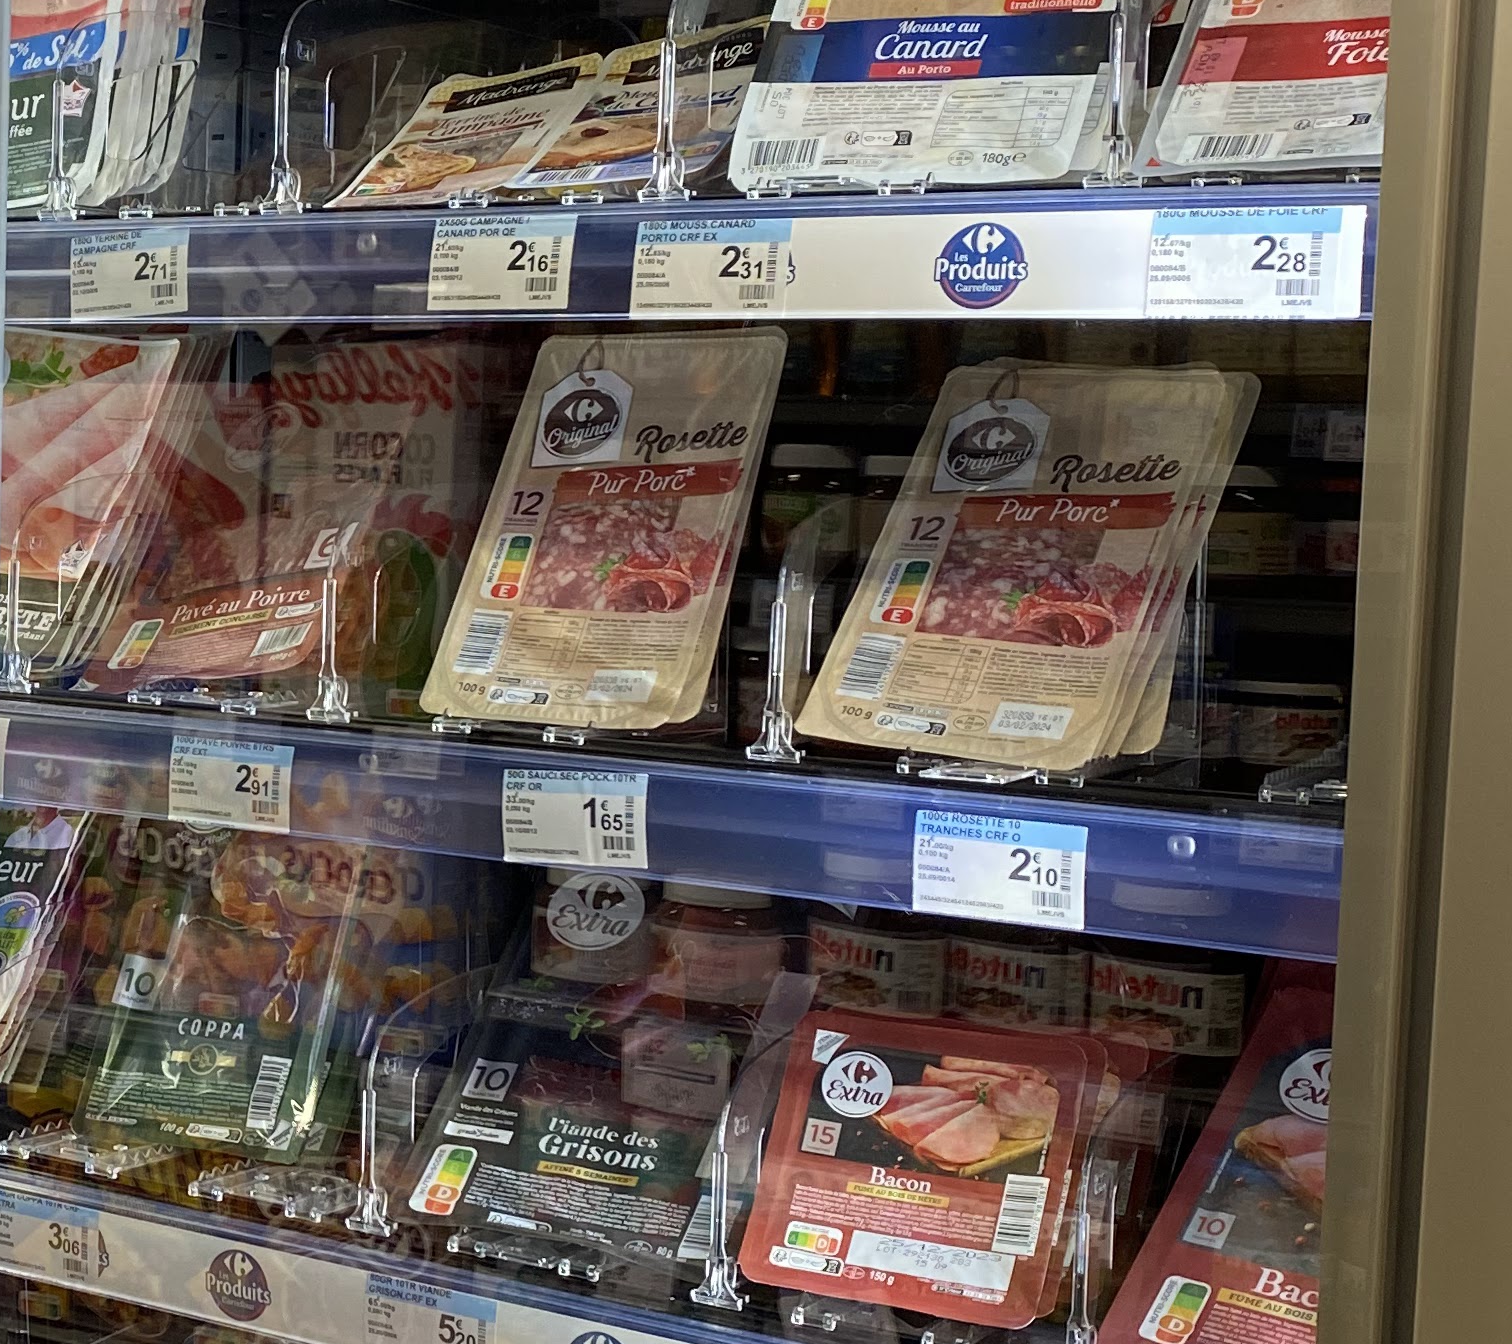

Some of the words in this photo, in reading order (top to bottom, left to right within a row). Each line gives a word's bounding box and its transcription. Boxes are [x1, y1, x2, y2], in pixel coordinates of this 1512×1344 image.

[897, 20, 958, 35] Mousse
[961, 22, 981, 34] au
[1324, 27, 1388, 43] Mousse
[875, 34, 988, 61] Canard
[898, 65, 914, 75] Au
[917, 64, 952, 76] Porto
[457, 76, 566, 105] Madrange
[436, 228, 474, 238] CANARD
[476, 228, 499, 237] POR
[640, 232, 673, 243] PORTO
[676, 232, 699, 242] CRF
[702, 232, 717, 241] EX
[935, 258, 1028, 281] Produits
[955, 282, 1003, 293] Carrefour
[547, 421, 618, 448] Original
[634, 422, 748, 462] Rosette
[950, 445, 1031, 474] Original
[588, 473, 627, 496] Pur
[1050, 454, 1182, 492] Rosette
[513, 491, 545, 515] 12
[996, 498, 1041, 523] Pur
[910, 516, 947, 540] 12
[170, 600, 215, 625] Pavé
[216, 600, 241, 614] au
[247, 586, 311, 608] Poivre
[506, 781, 525, 790] CRF
[528, 782, 543, 791] OR
[920, 823, 983, 838] TRANCHES
[985, 830, 1009, 840] CRF
[552, 905, 630, 937] Extra
[124, 967, 155, 997] 10
[178, 1017, 245, 1041] COPPA
[474, 1064, 514, 1091] 10
[826, 1079, 884, 1106] Extra
[549, 1118, 619, 1143] Viande
[623, 1129, 660, 1149] des
[811, 1125, 835, 1145] 15
[539, 1134, 659, 1172] Grisons
[869, 1166, 932, 1194] Bacon
[1196, 1215, 1225, 1238] 10
[869, 1270, 884, 1280] 150
[204, 1273, 272, 1304] Produits
[1228, 1292, 1263, 1308] FUMÉ
[1266, 1303, 1282, 1313] AU
[1284, 1307, 1314, 1321] BOIS
